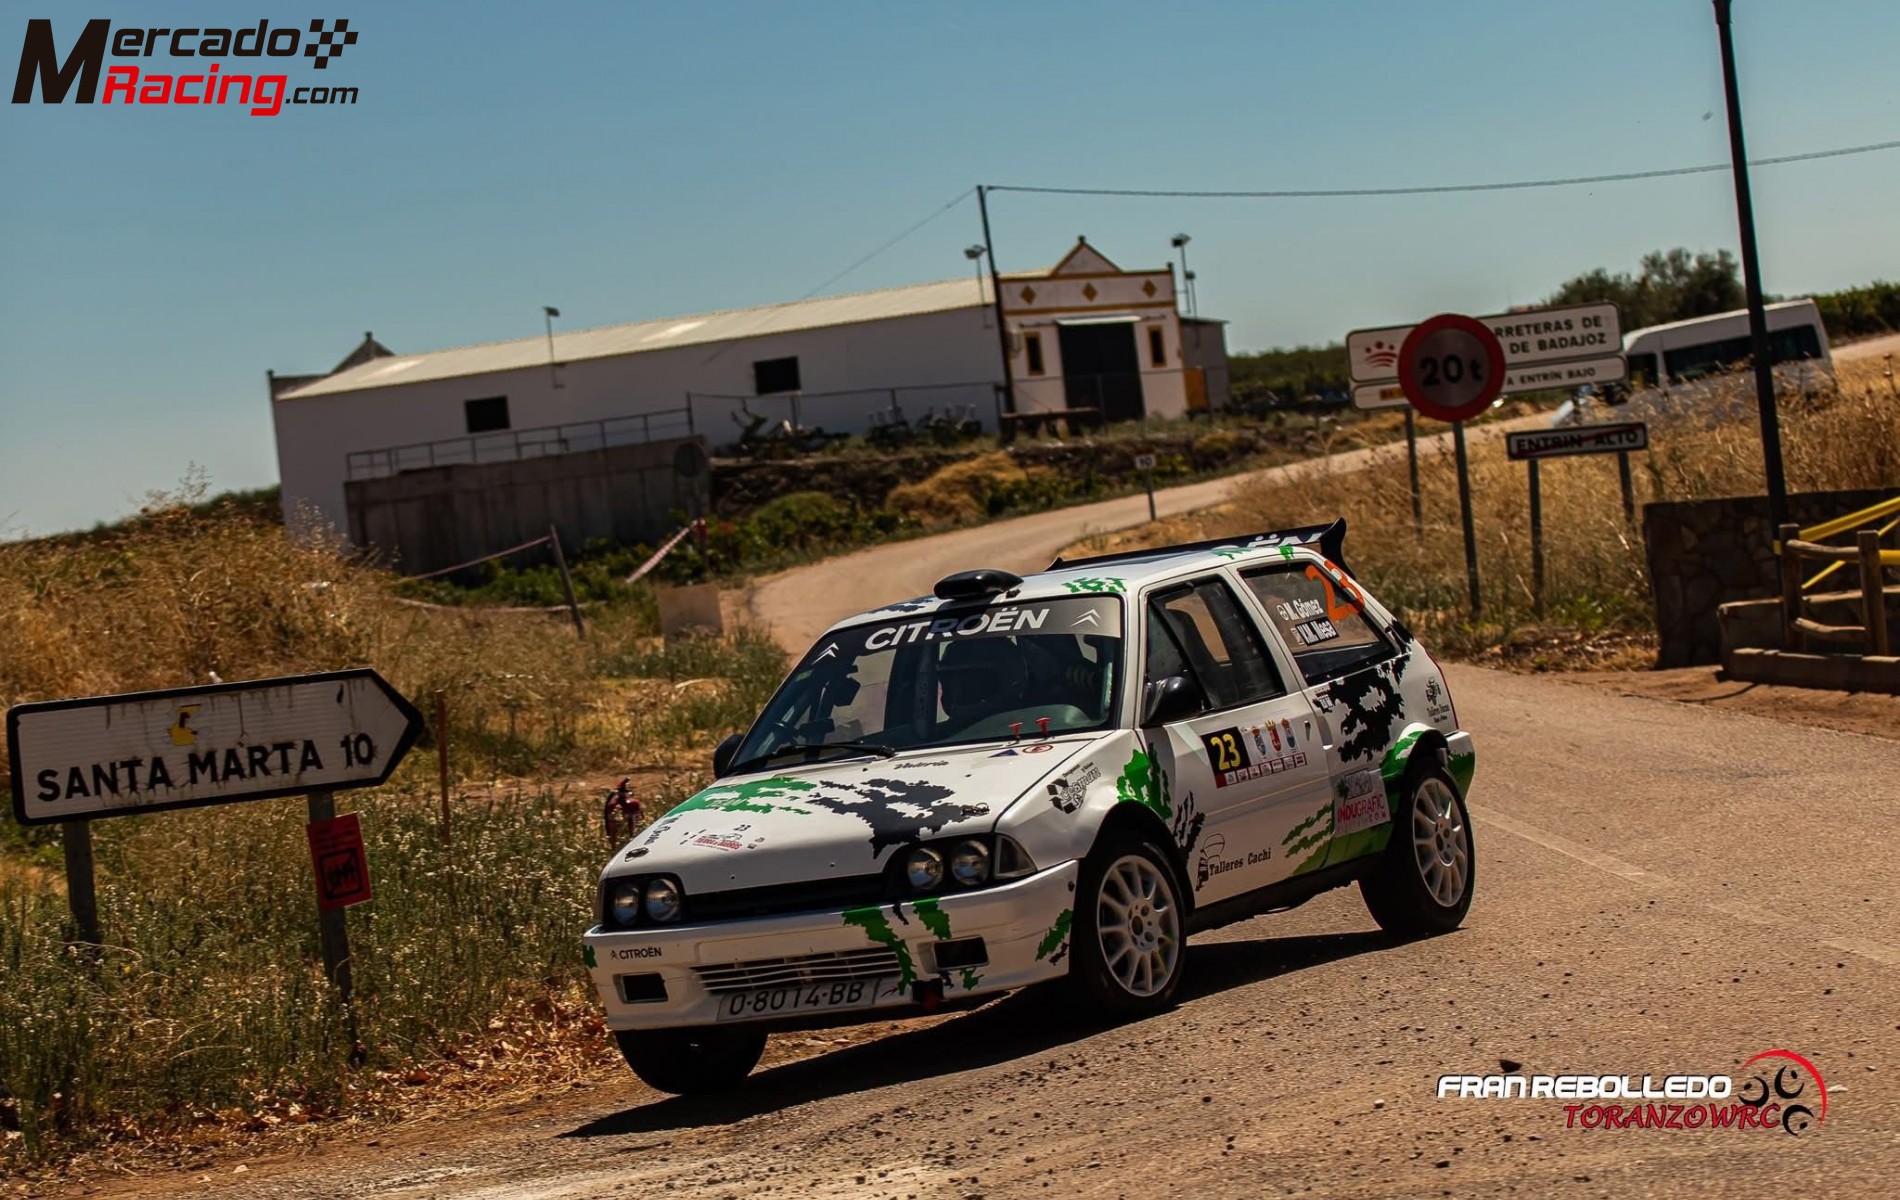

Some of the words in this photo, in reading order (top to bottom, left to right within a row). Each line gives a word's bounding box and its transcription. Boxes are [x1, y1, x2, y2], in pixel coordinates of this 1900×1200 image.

[1494, 319, 1574, 338] RRETERAS
[1582, 315, 1603, 328] DE
[1509, 341, 1530, 354] DE
[1537, 332, 1607, 351] BADAJOZ
[1419, 354, 1464, 387] 20
[1469, 357, 1485, 382] t
[1567, 367, 1596, 379] BAJO
[1593, 428, 1639, 446] ALTO
[864, 607, 1051, 651] CITROËN
[1210, 733, 1241, 770] 23
[37, 756, 174, 802] SANTA
[187, 739, 324, 785] MARTA
[340, 731, 374, 767] 10
[1208, 858, 1244, 876] Talleres
[1247, 847, 1272, 865] Cachi
[619, 946, 663, 960] CITROËN
